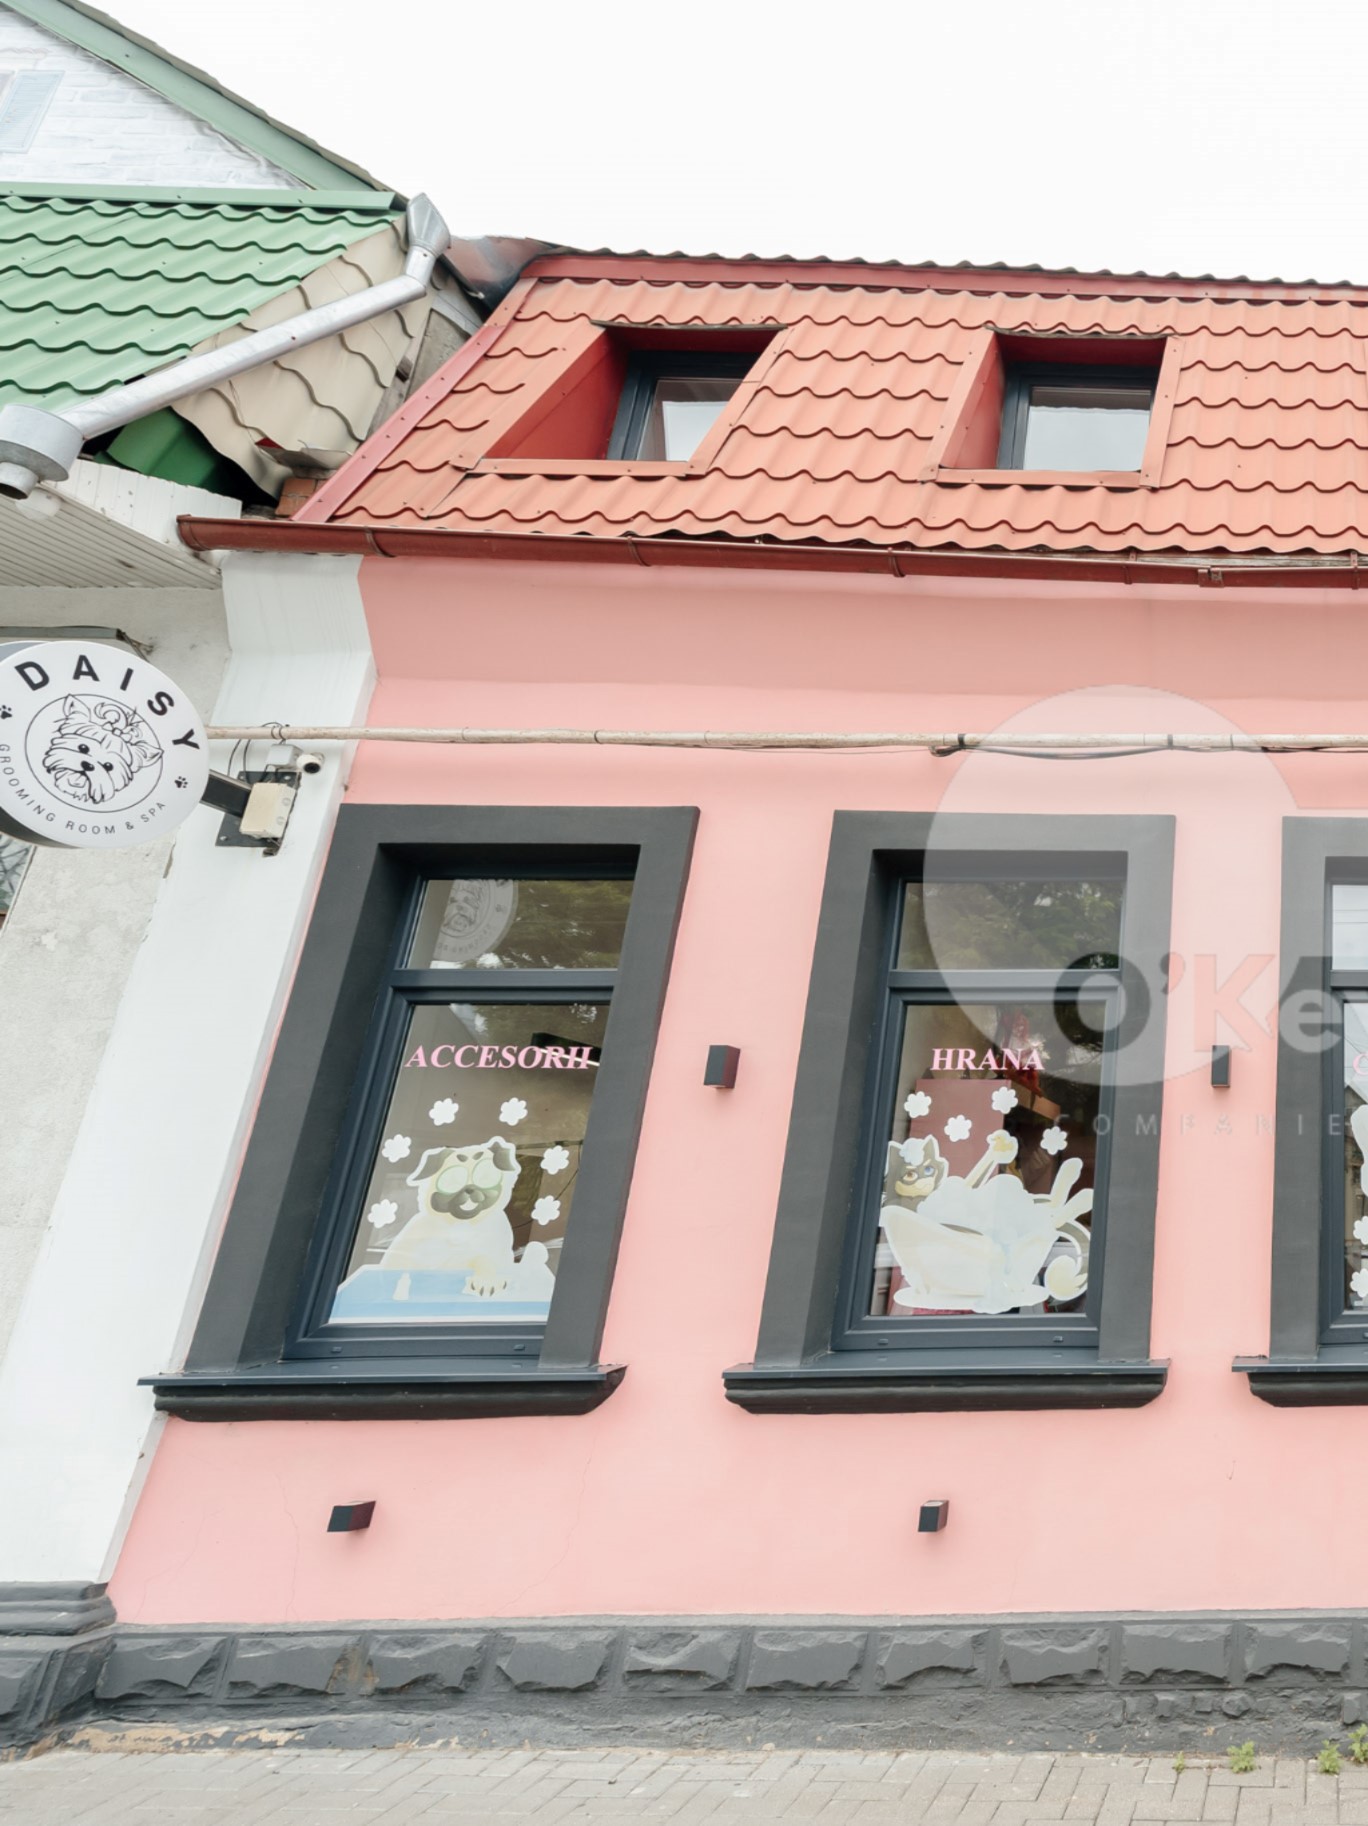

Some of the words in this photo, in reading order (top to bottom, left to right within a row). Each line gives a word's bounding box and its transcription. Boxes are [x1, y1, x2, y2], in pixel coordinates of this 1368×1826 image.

[15, 654, 200, 751] DAISY
[0, 743, 56, 822] GROOMING
[65, 820, 116, 834] ROOM
[125, 821, 134, 830] &
[140, 802, 166, 823] SPA
[404, 1044, 593, 1070] ACCESORII
